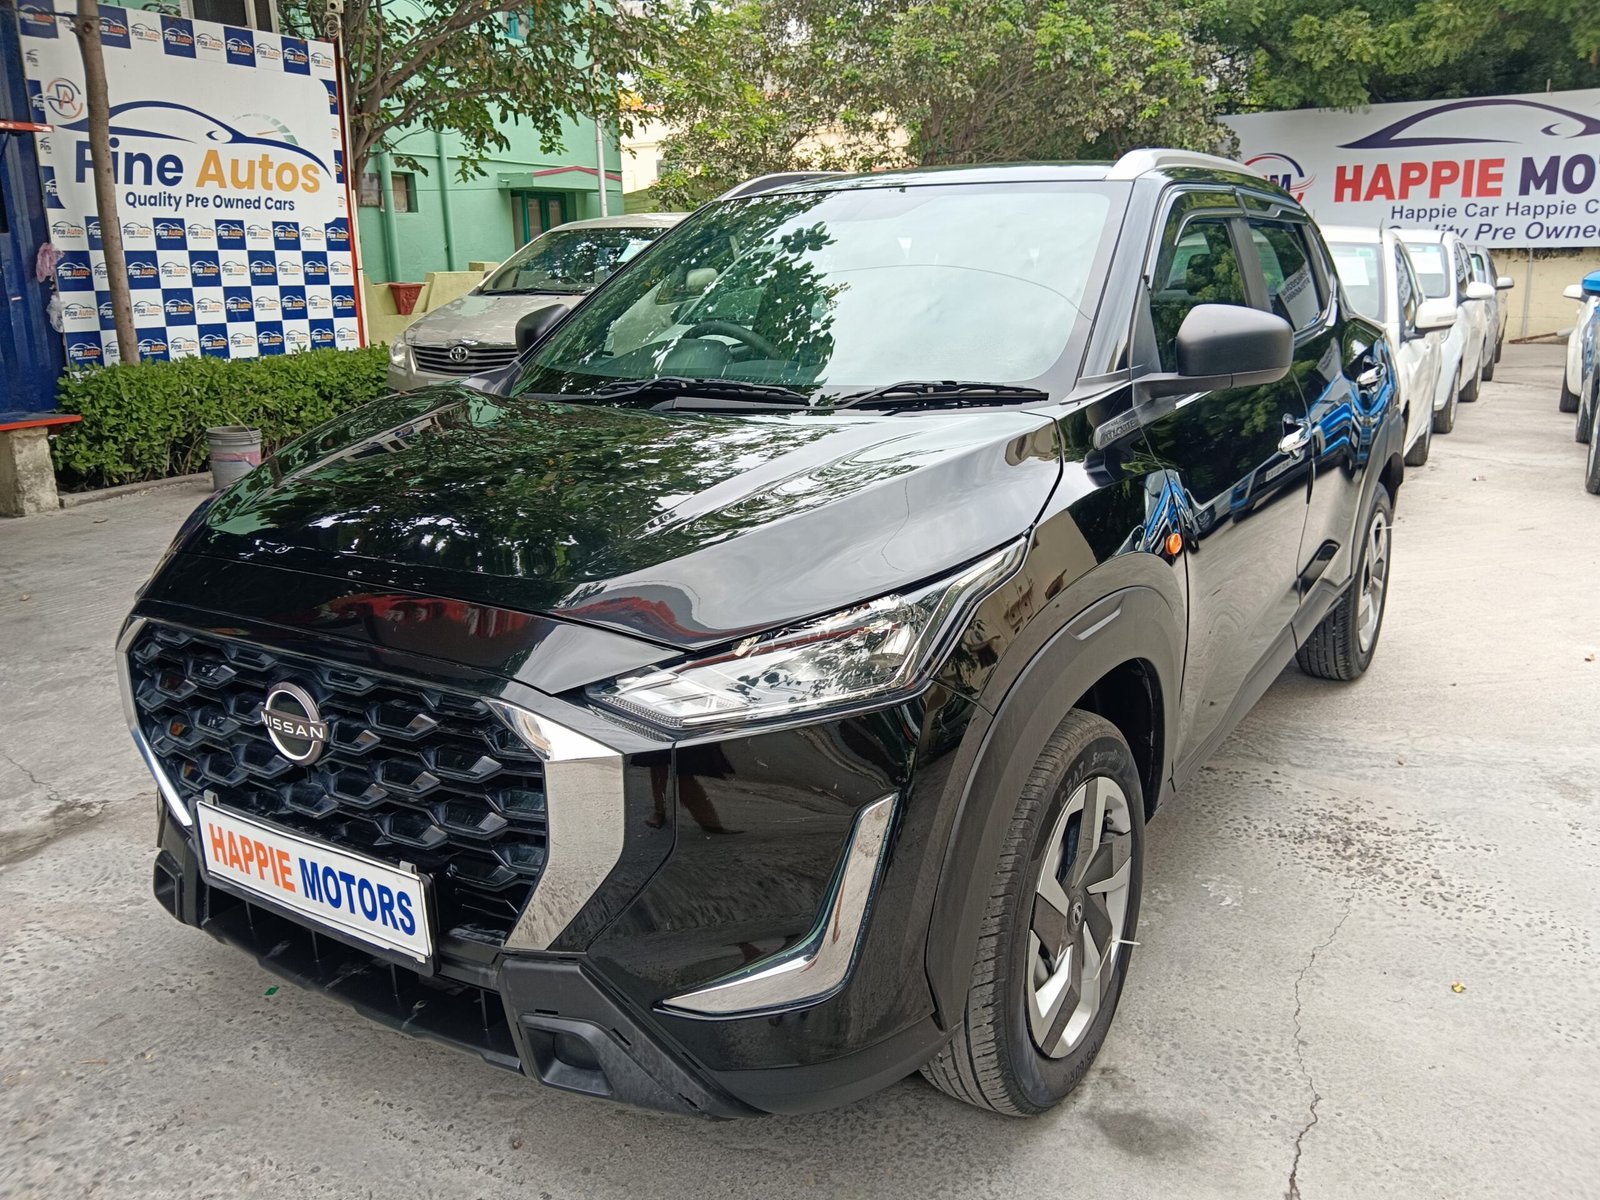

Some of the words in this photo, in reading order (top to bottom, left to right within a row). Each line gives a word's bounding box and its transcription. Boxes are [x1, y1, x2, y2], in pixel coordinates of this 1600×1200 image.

[195, 149, 321, 194] Autos
[1334, 157, 1505, 203] HAPPIE
[1518, 153, 1600, 196] MO
[125, 191, 182, 212] Quality
[186, 193, 209, 208] Pre
[213, 194, 261, 210] Owned
[264, 196, 295, 211] Cars
[1391, 203, 1457, 222] Happie
[1465, 203, 1499, 218] Car
[1506, 200, 1577, 219] Happie
[1474, 223, 1516, 240] Pre
[261, 711, 324, 739] NISSAN
[208, 822, 297, 893] HAPPIE
[298, 856, 417, 937] MOTORS
